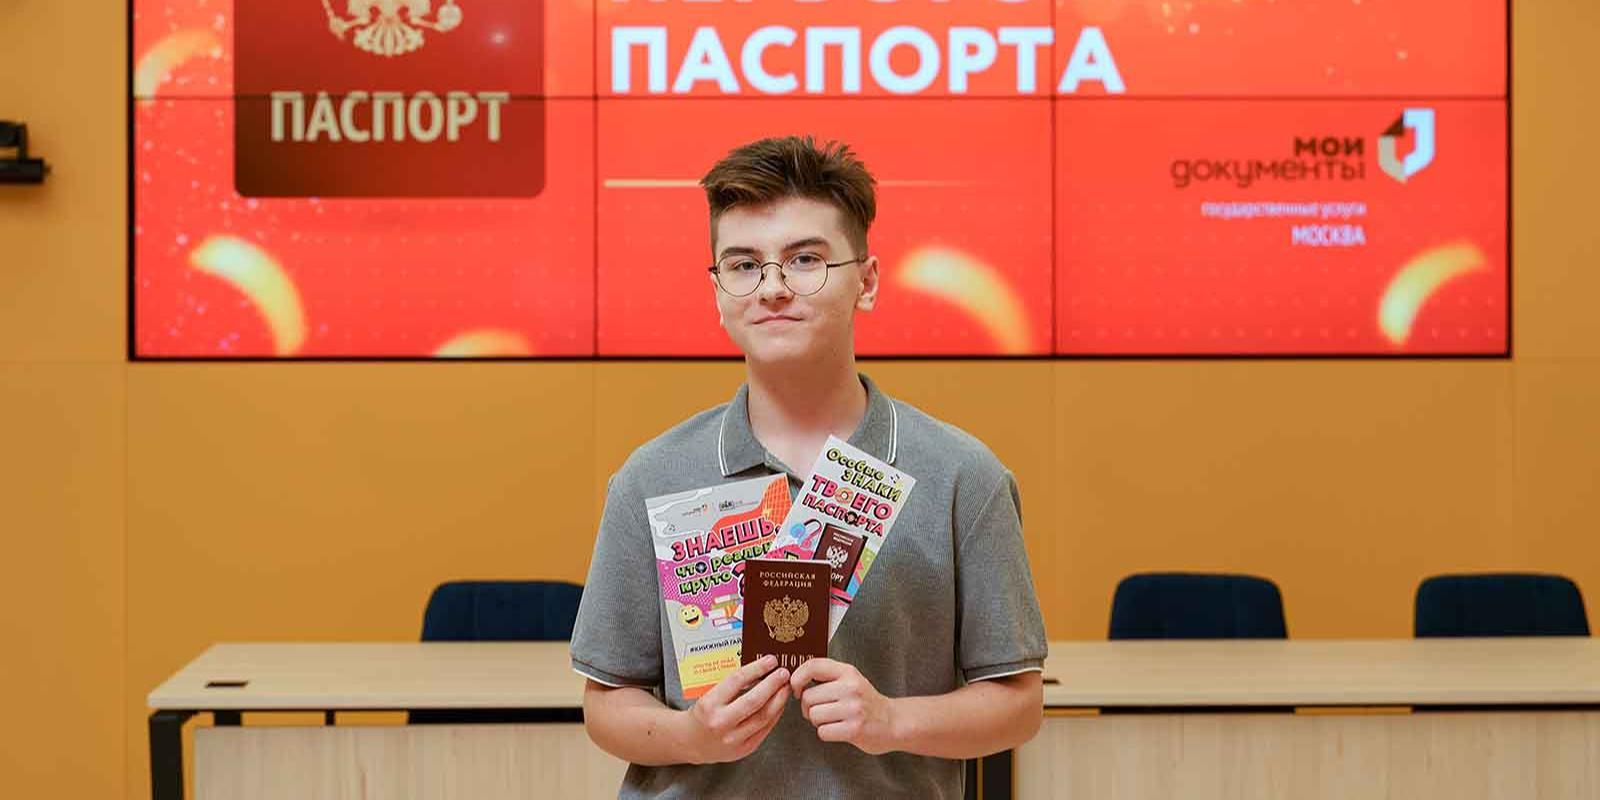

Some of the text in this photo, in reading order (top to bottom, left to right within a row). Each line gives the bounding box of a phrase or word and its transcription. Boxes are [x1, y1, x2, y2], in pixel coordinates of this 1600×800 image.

[611, 25, 1126, 94] ПАСПОРТА
[271, 91, 509, 142] ПАСПОРТ
[1201, 202, 1366, 219] государственные услуги
[1292, 225, 1366, 245] МОСКВА
[827, 448, 885, 481] Особые
[811, 474, 893, 520] ТВОЕГО
[841, 469, 902, 503] ЗНАКИ
[802, 493, 885, 537] ПАСПОРТА
[711, 541, 772, 572] реальн
[679, 571, 732, 595] круто
[760, 571, 816, 580] РОССИЙСКАЯ
[763, 580, 812, 588] ФЕДЕРАЦИЯ
